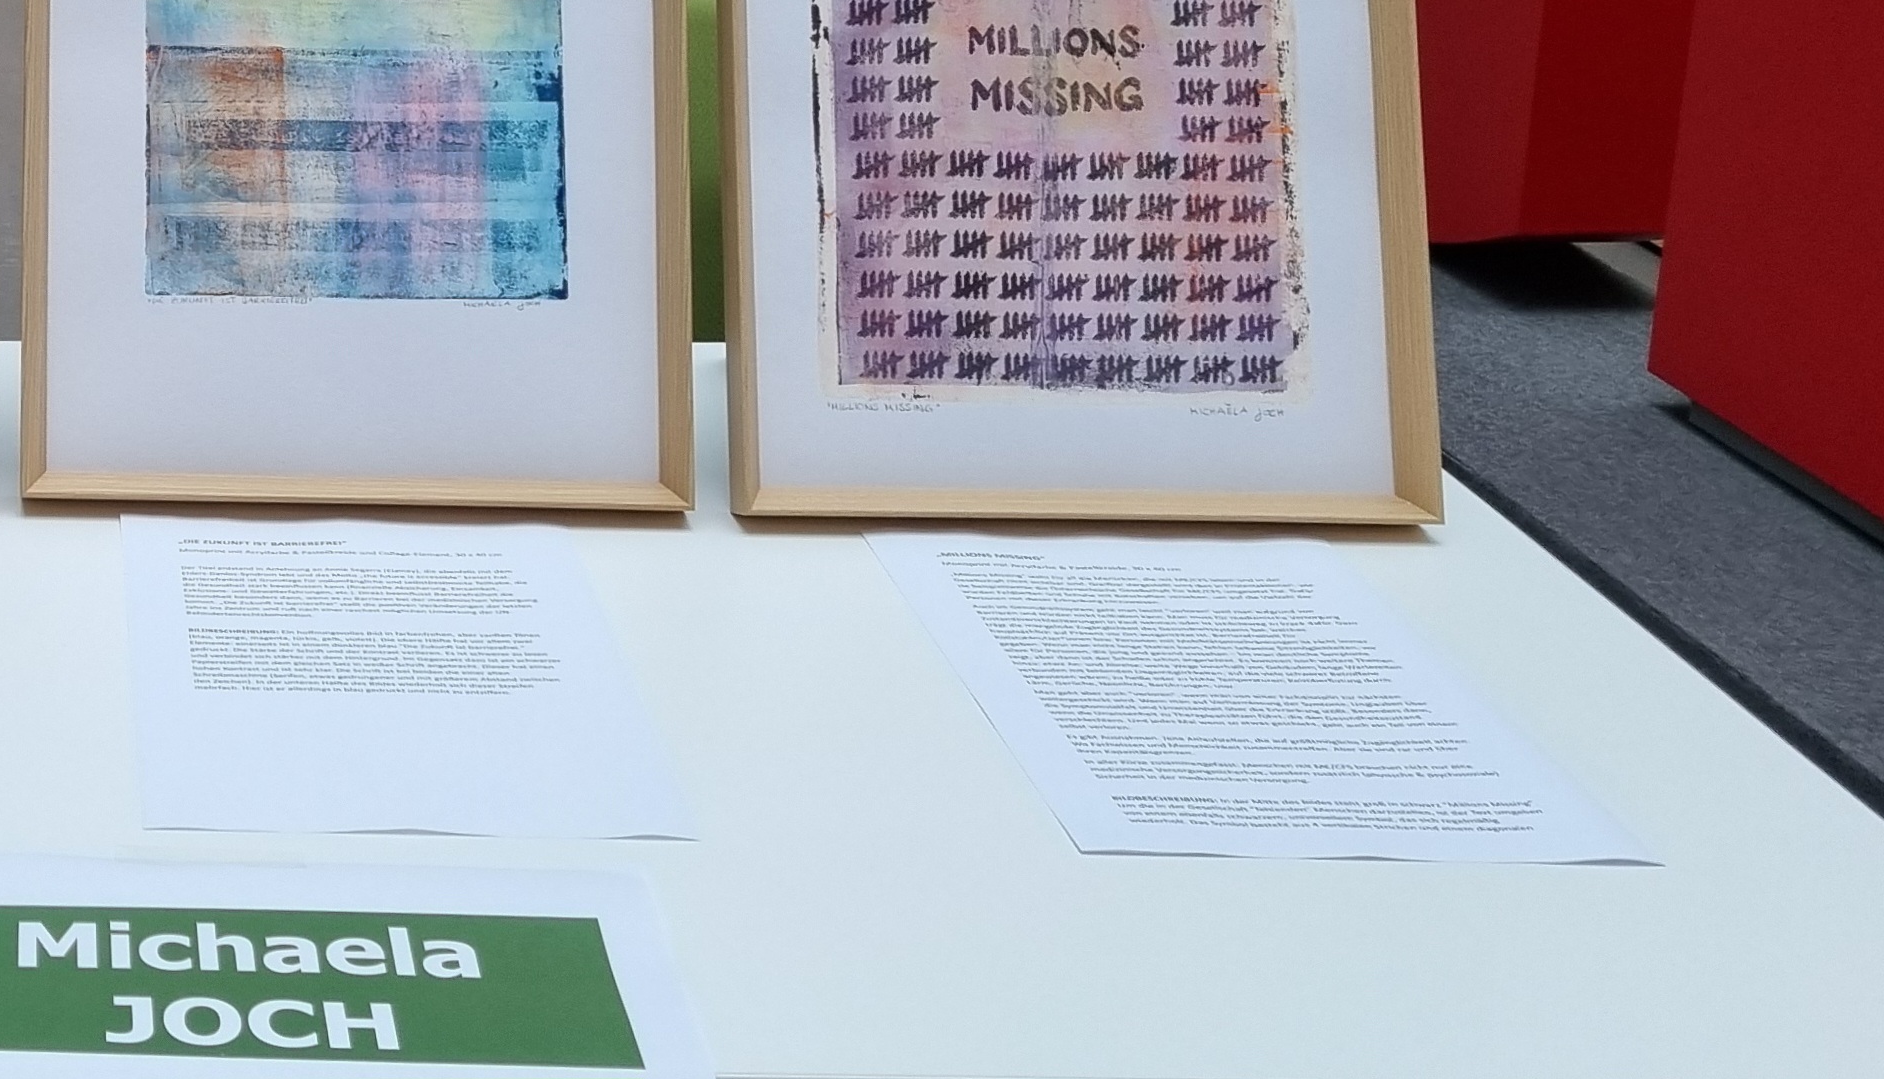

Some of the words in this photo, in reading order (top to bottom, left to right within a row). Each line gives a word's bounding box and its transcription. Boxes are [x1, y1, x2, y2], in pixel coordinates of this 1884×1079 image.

[968, 24, 1143, 58] MILLIONS
[970, 77, 1144, 117] MISSING
[17, 921, 482, 978] Michaela
[105, 995, 401, 1051] JOCH
